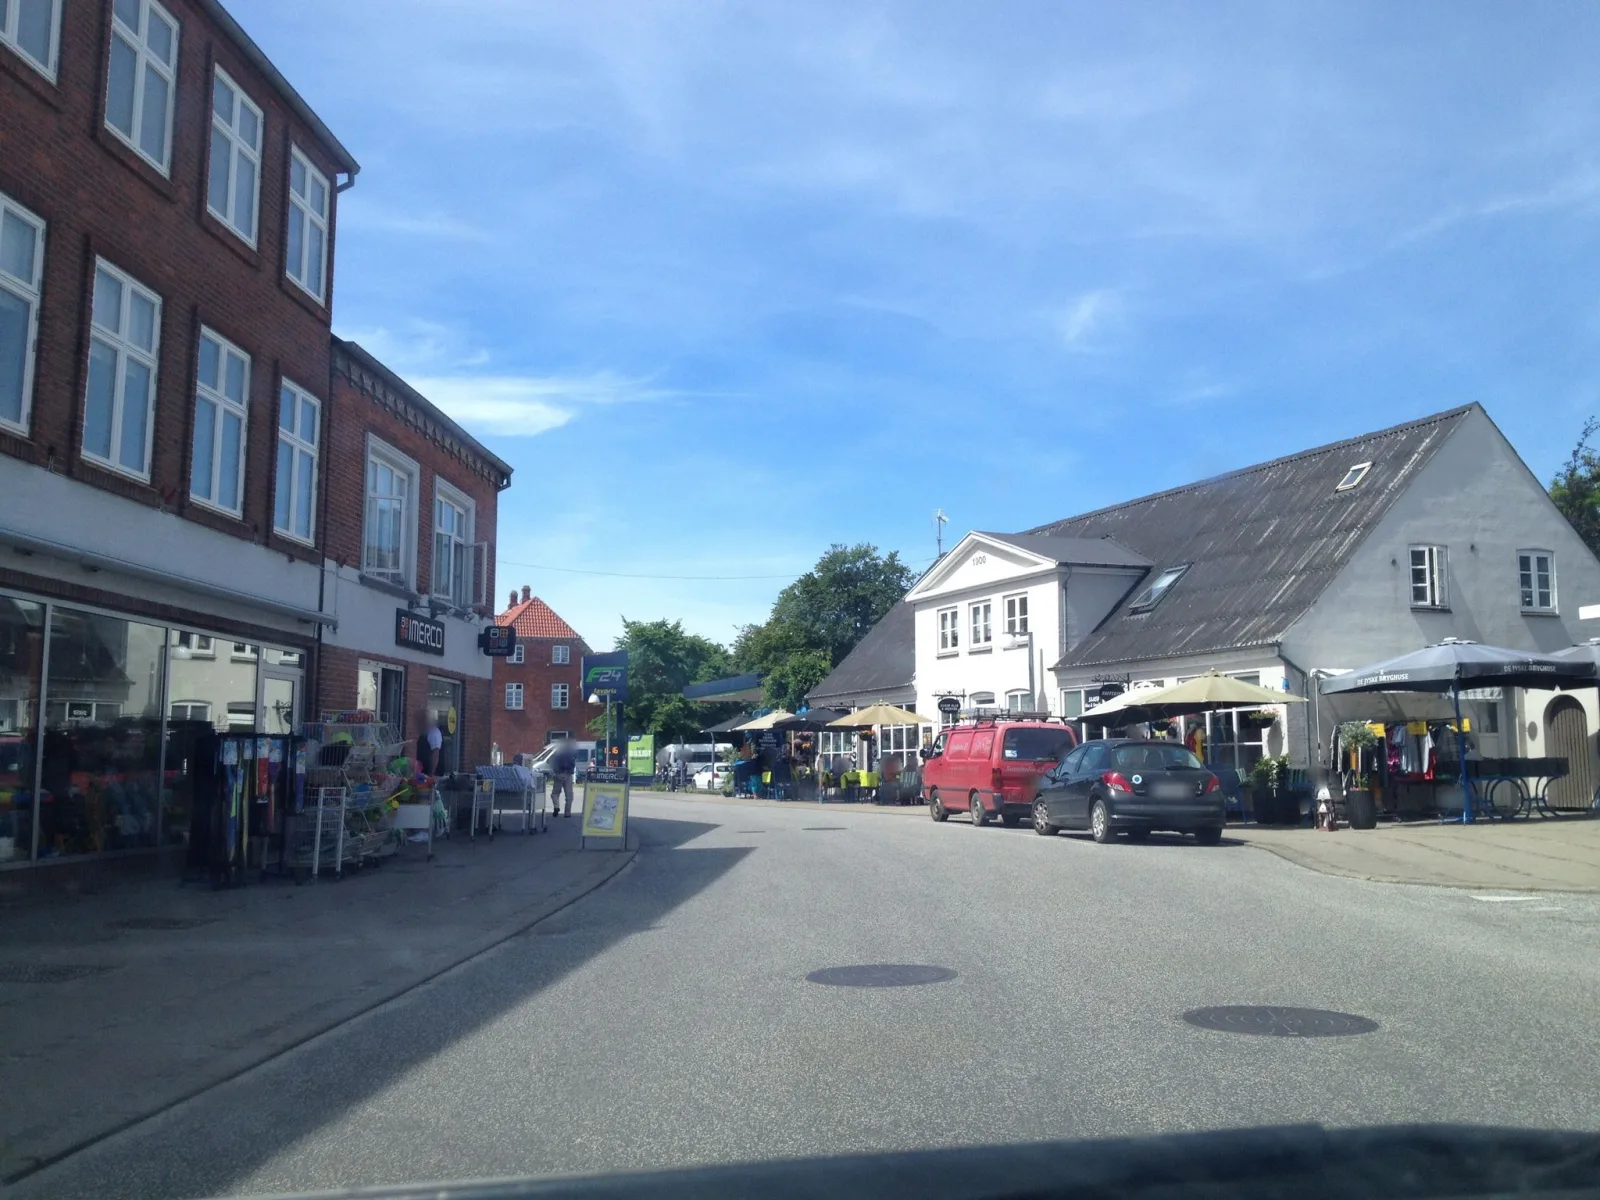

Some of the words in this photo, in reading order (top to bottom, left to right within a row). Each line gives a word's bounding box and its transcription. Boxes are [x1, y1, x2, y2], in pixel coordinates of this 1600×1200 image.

[408, 618, 442, 648] IMERCO
[585, 666, 625, 682] F24
[1379, 673, 1409, 682] BRYGHUSE
